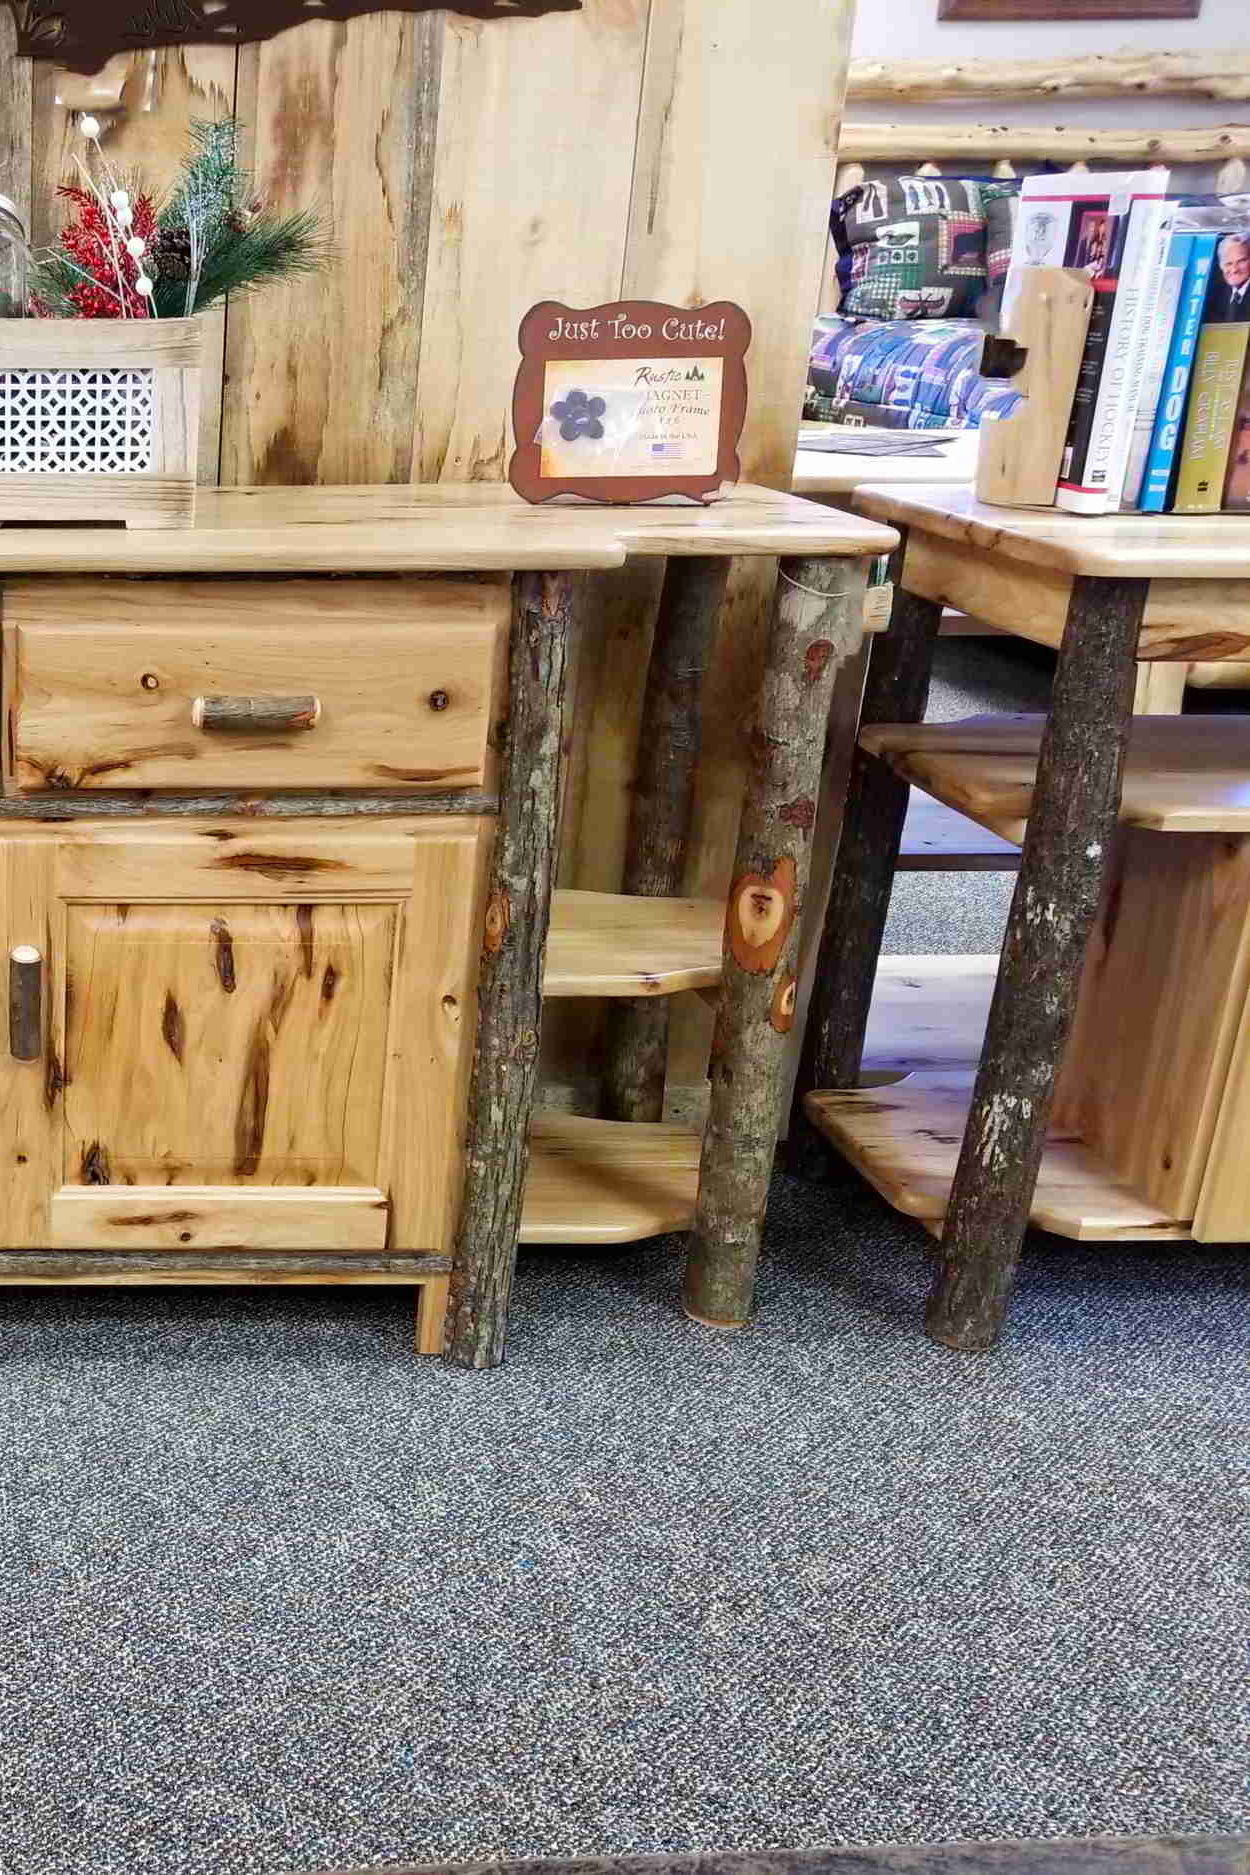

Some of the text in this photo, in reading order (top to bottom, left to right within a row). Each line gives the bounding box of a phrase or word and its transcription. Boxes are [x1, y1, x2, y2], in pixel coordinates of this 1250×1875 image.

[548, 312, 727, 341] Just Too Cute!
[634, 366, 683, 386] Rustic
[670, 403, 712, 417] Frame
